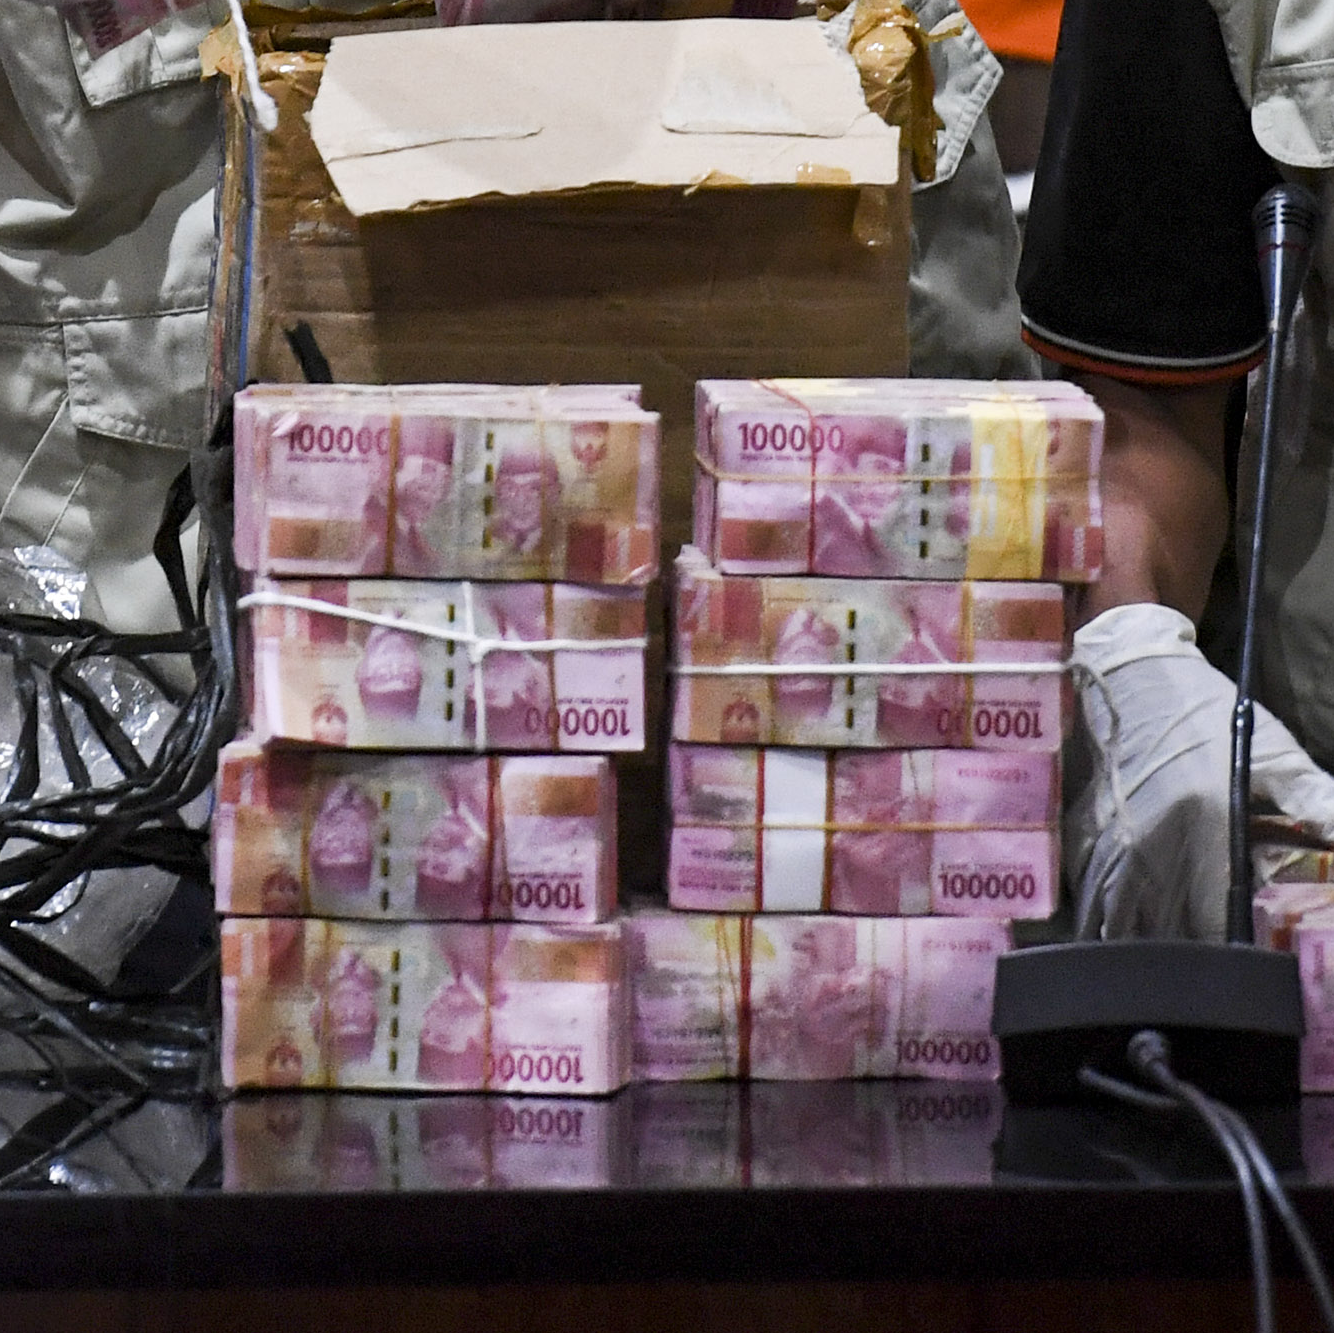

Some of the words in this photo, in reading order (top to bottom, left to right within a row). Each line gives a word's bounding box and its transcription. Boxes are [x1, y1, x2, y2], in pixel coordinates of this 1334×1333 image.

[737, 421, 844, 453] 100000
[936, 707, 1044, 739] 10000
[937, 871, 1036, 900] 100000
